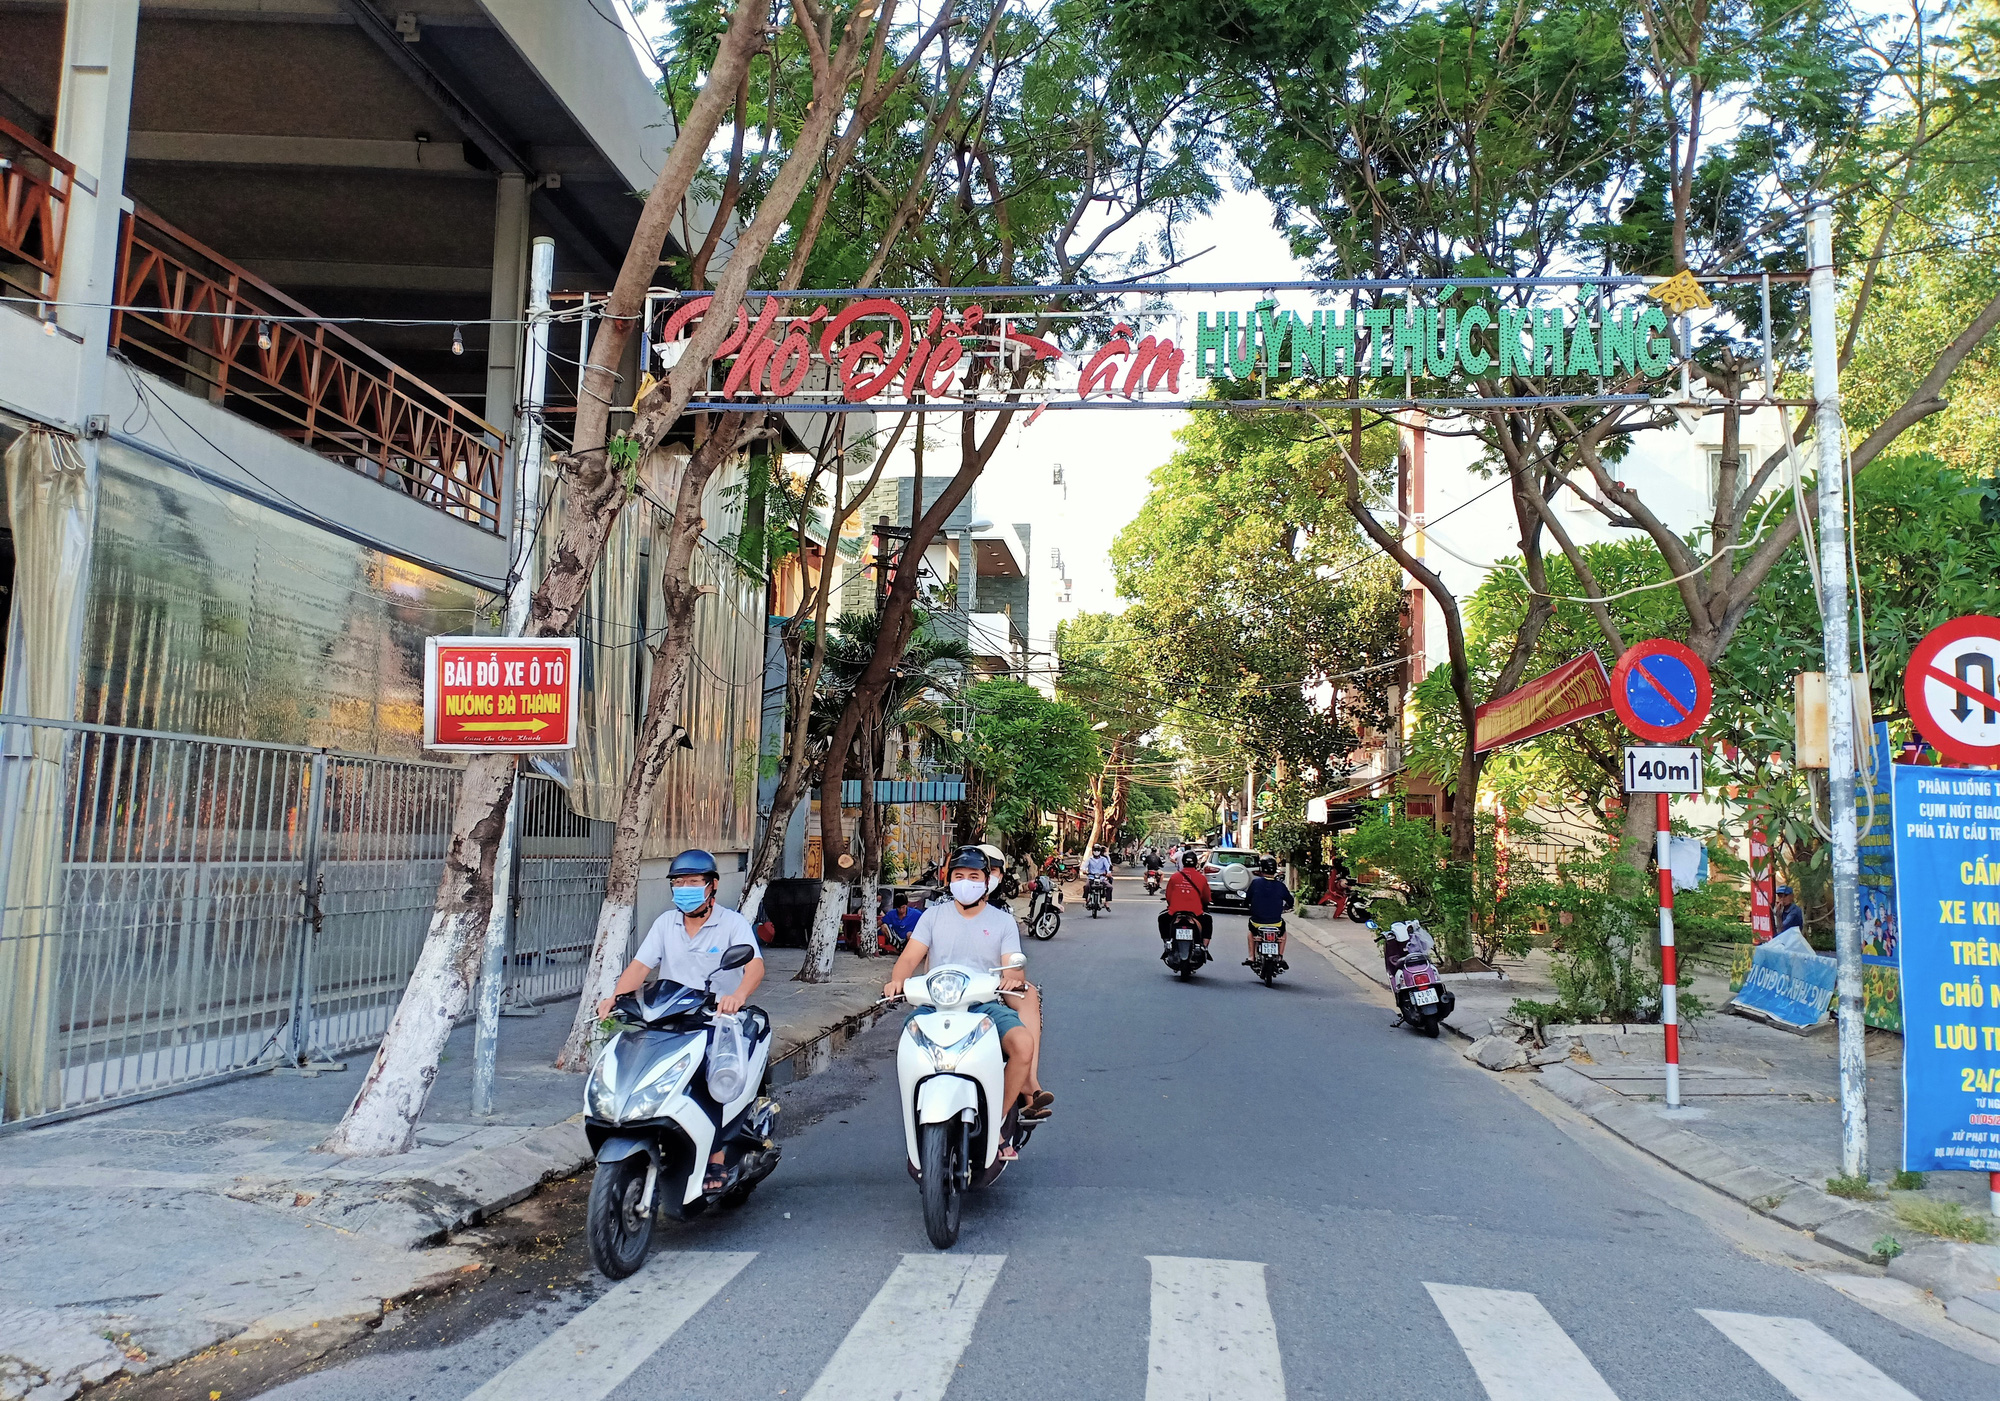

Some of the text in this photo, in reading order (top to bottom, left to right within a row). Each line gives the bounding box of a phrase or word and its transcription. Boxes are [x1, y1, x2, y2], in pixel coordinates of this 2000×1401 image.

[1363, 283, 1492, 378] THÚC
[1499, 282, 1671, 378] KHÁNG
[444, 652, 564, 687] BÃI ĐỖ XE Ô TÔ
[445, 690, 561, 716] NƯỚNG ĐÀ THÀNH
[1637, 760, 1690, 781] 40m
[1917, 777, 1951, 795] PHÂN
[1919, 801, 2000, 821] CỤM NÚT GIAO
[1906, 821, 1935, 839] PHÍA
[1937, 822, 1960, 840] TÂY
[1960, 853, 2000, 886] CẤM
[1939, 900, 1967, 925] XE
[1940, 974, 1984, 1008] CHỖ
[1934, 1023, 1977, 1051] LƯU
